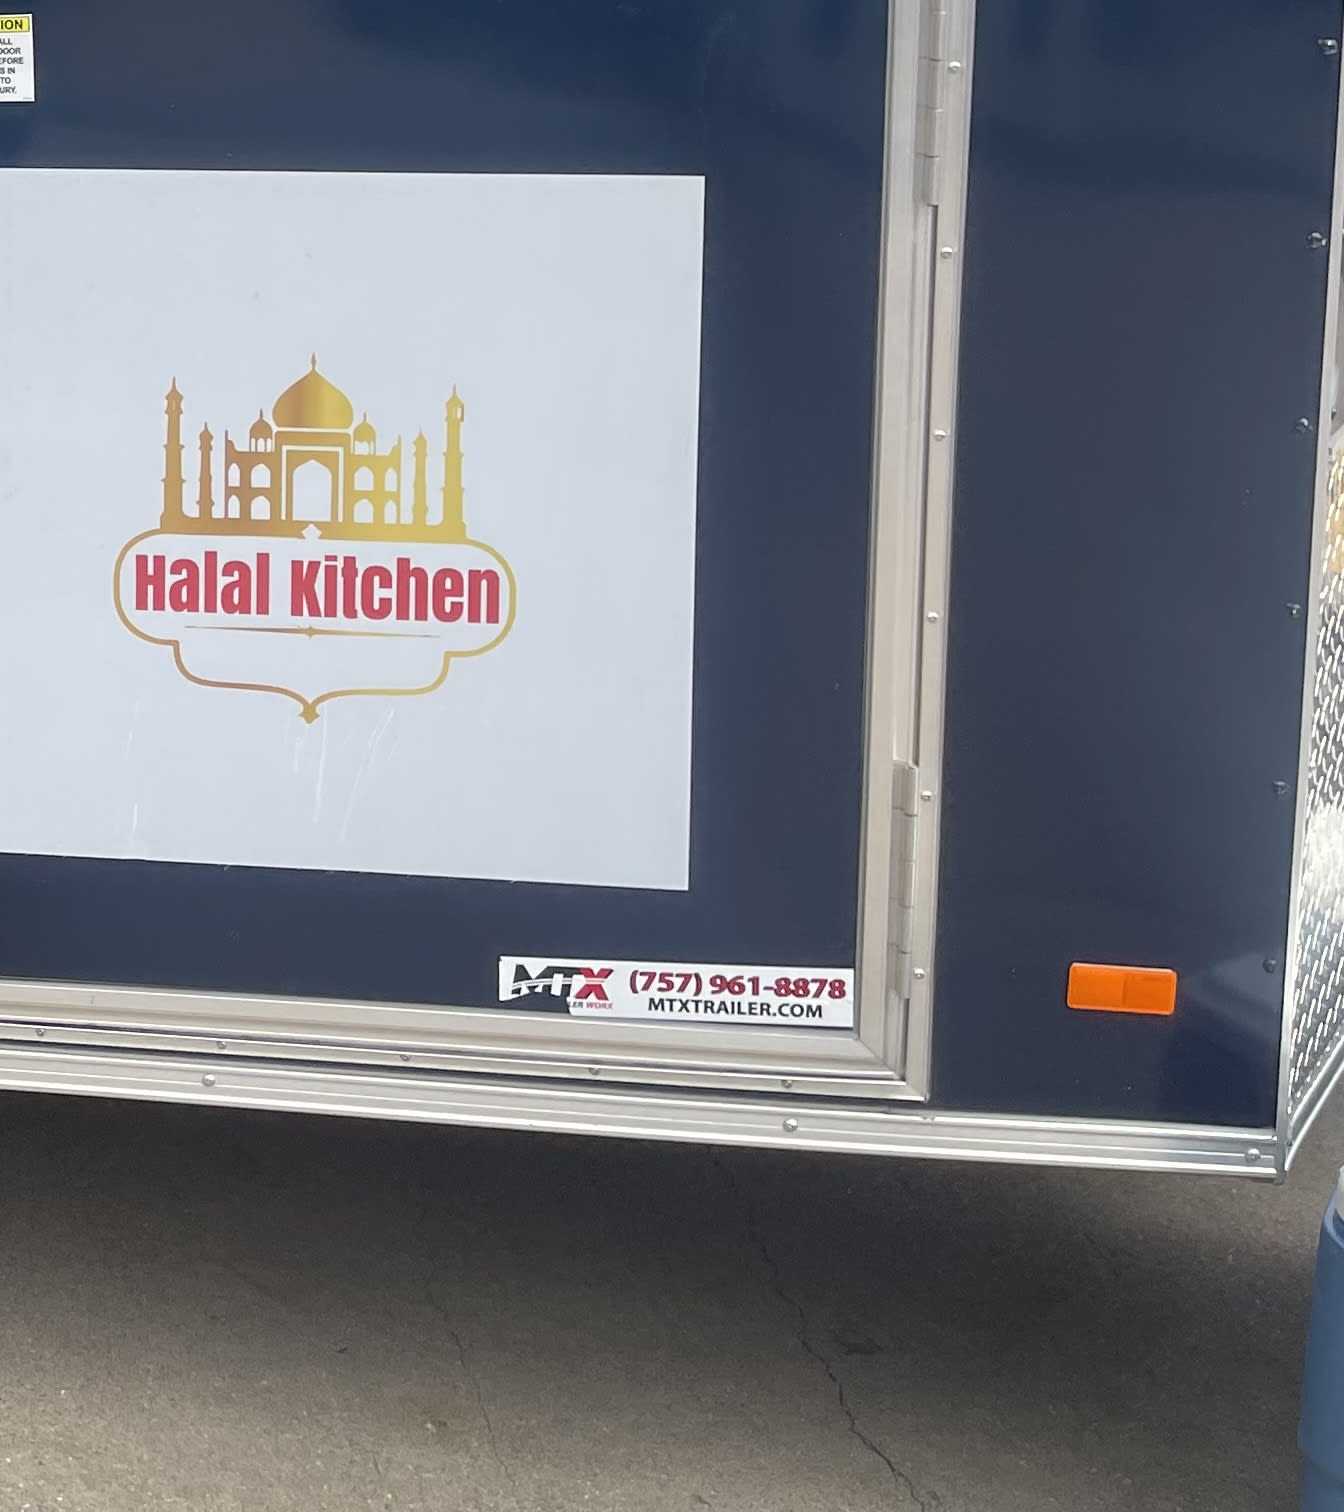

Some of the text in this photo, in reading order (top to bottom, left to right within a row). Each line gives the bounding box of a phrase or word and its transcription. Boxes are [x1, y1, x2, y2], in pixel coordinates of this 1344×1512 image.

[135, 549, 501, 626] Halal Kitchen
[629, 970, 846, 999] (757) 961-8878
[647, 997, 823, 1018] MTXTRAILER.COM
